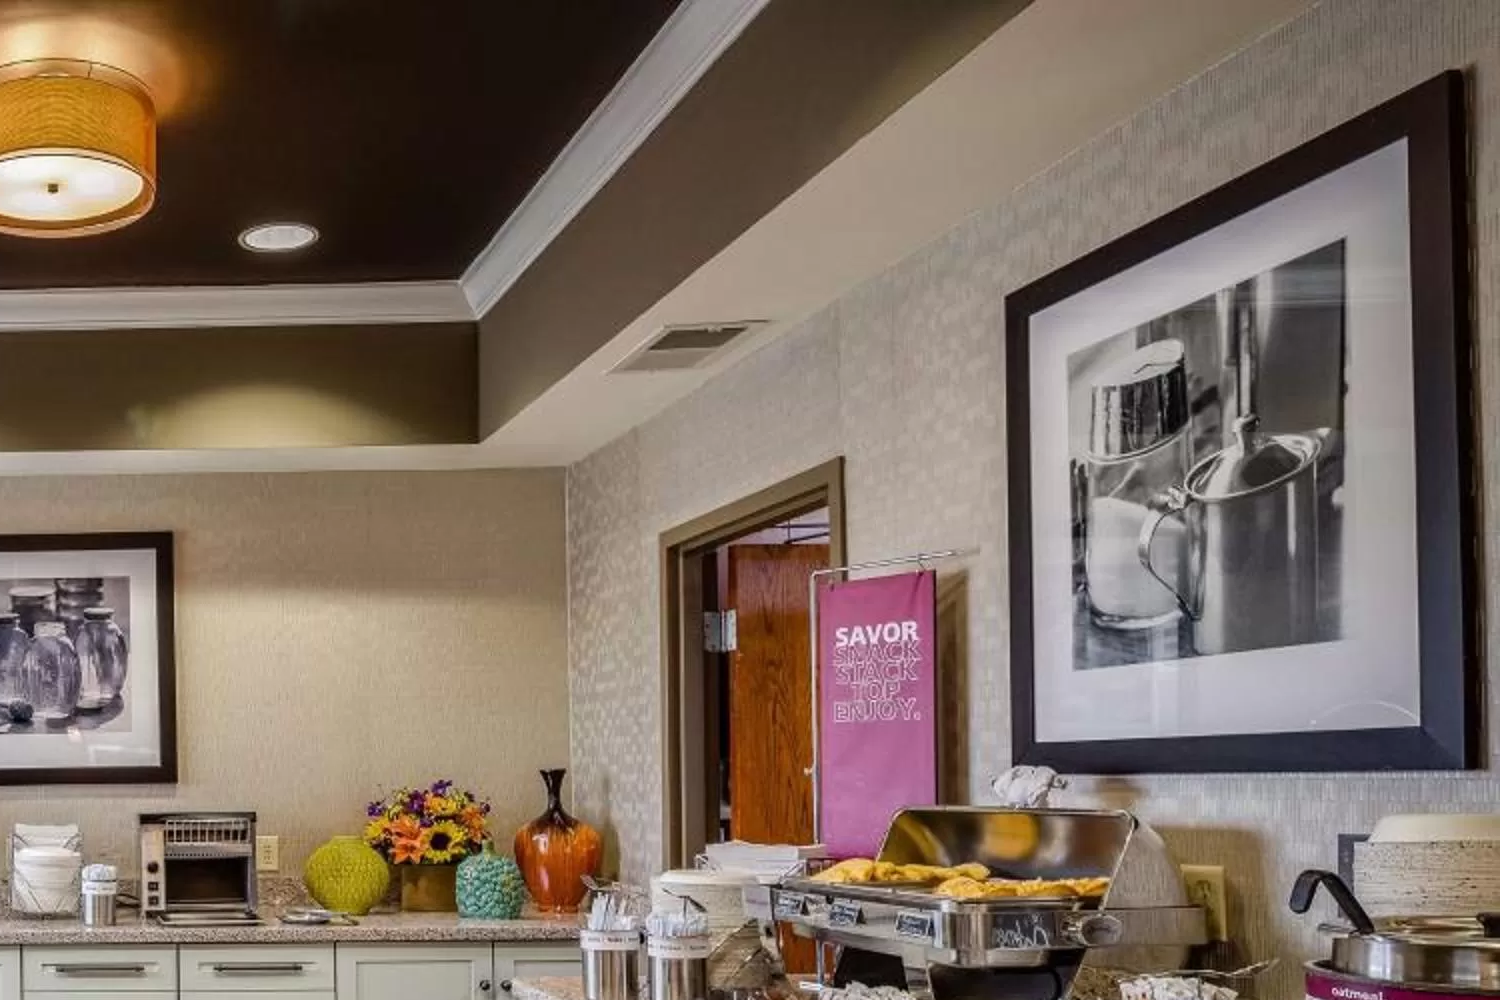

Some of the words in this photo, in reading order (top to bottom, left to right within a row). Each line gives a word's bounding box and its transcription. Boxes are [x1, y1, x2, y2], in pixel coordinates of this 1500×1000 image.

[835, 621, 918, 647] SAVOR
[835, 660, 918, 685] STACK
[850, 680, 901, 701] TOP
[833, 697, 921, 723] ENJOY.
